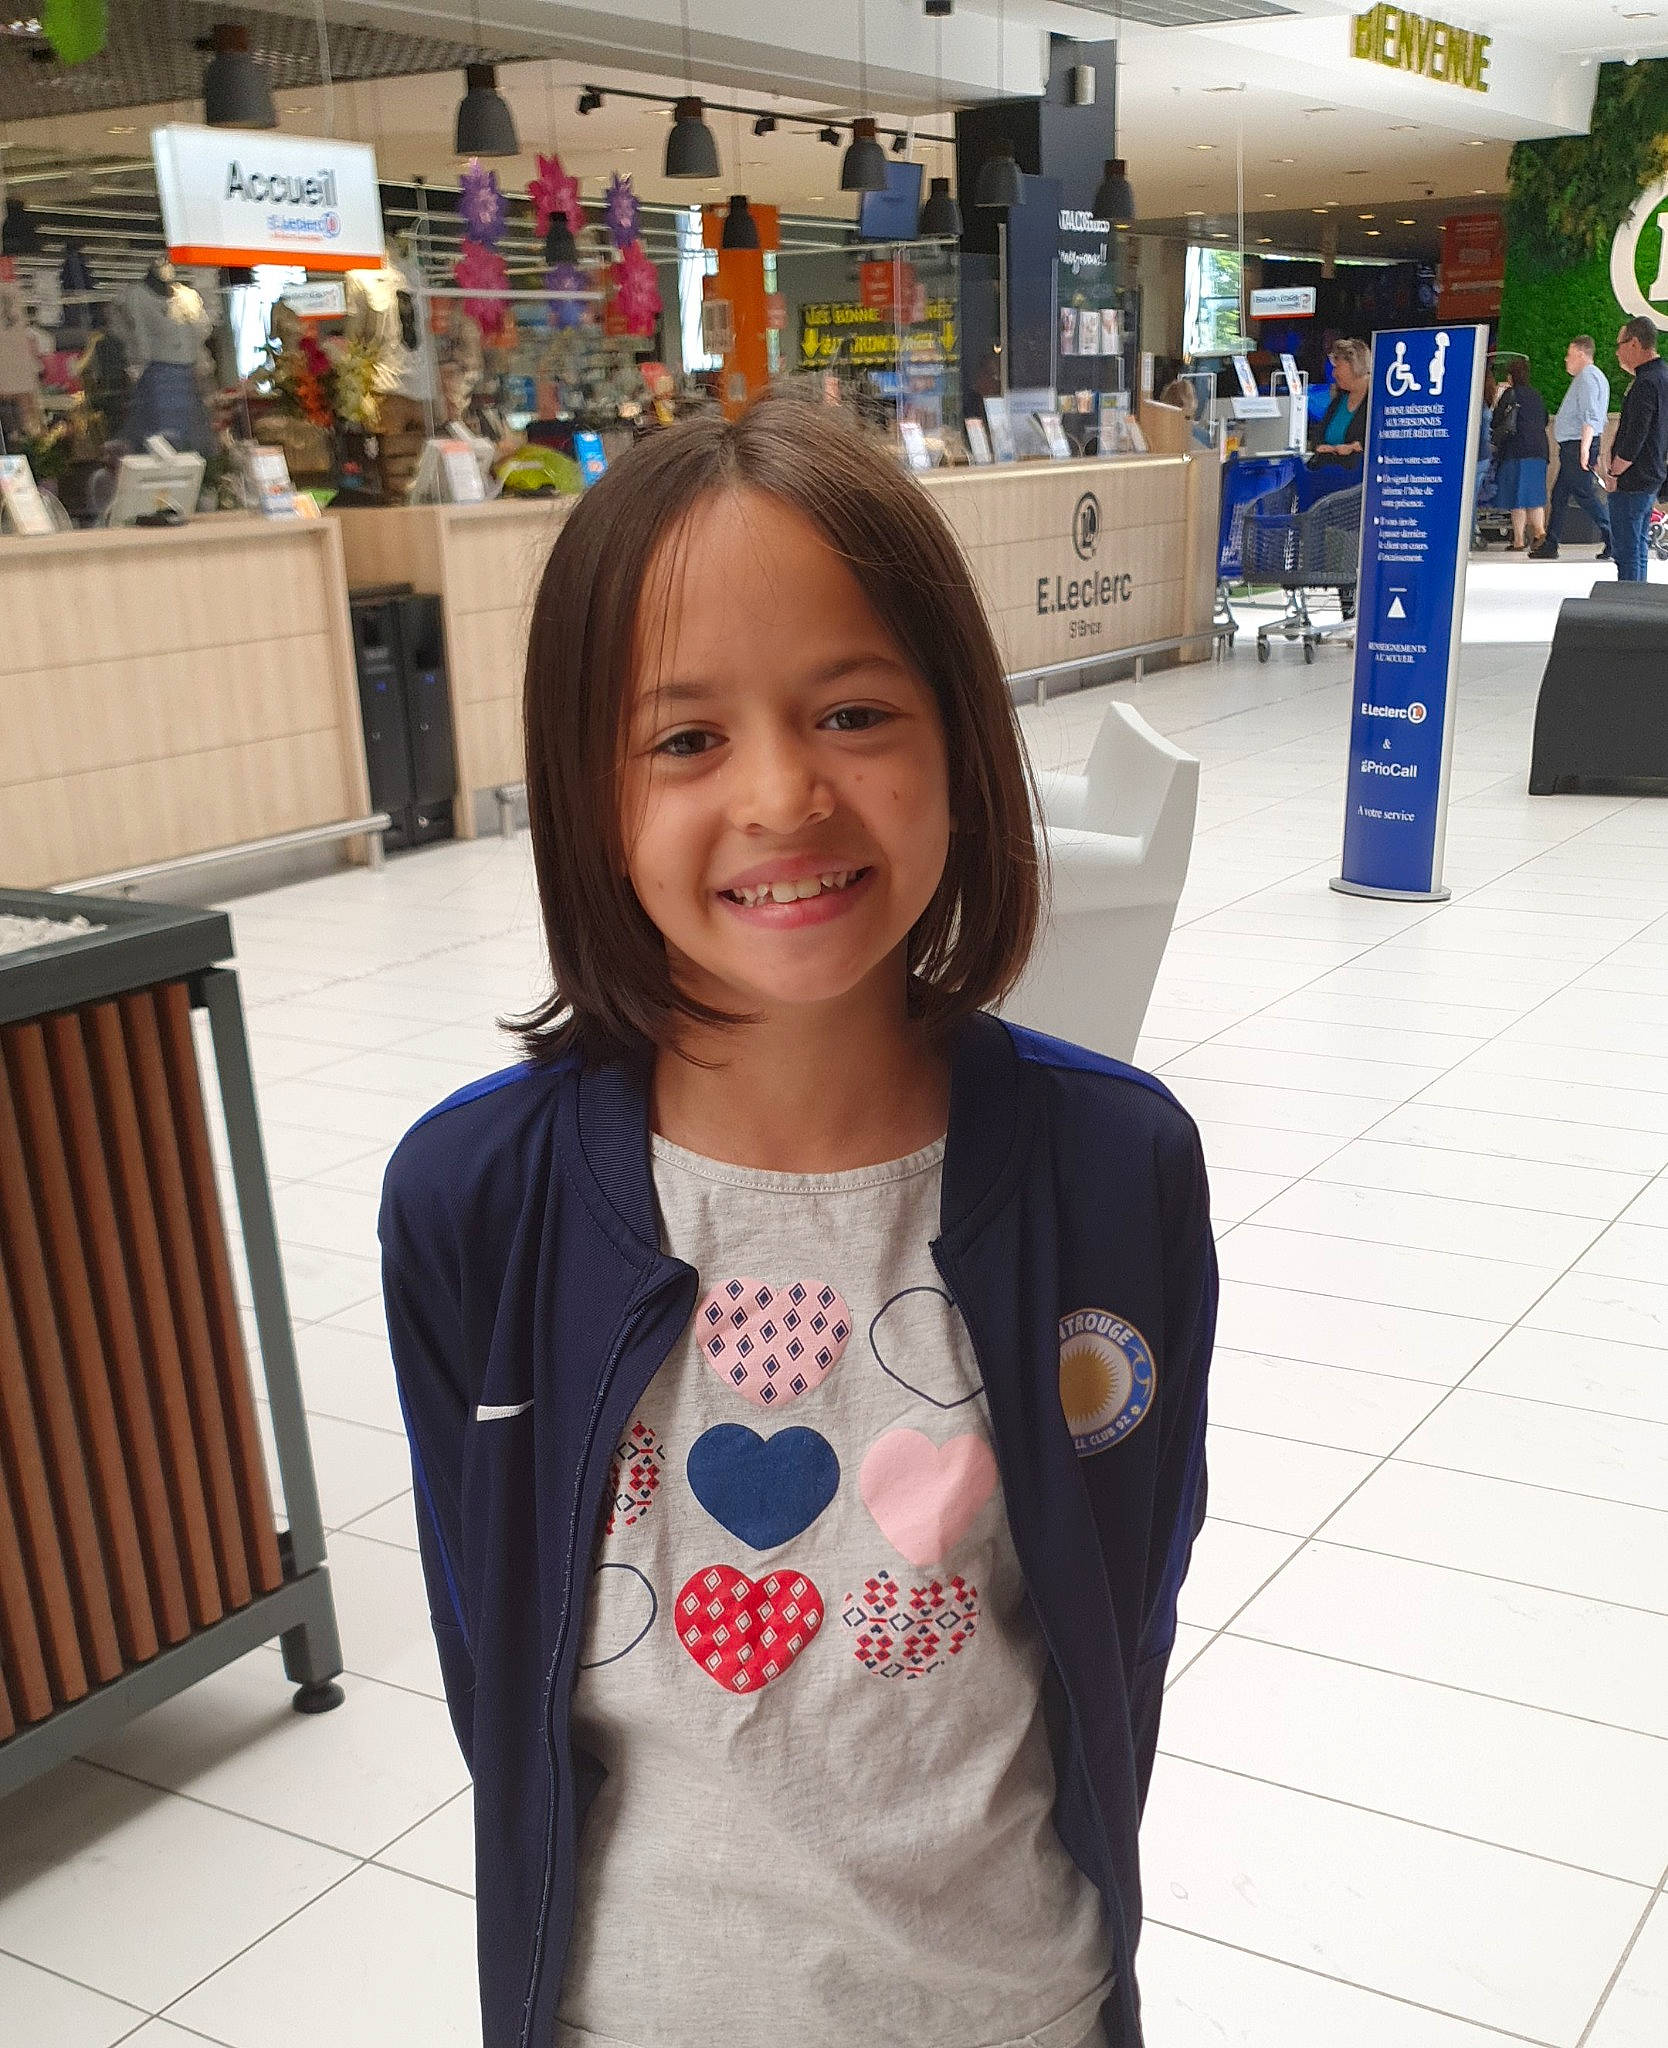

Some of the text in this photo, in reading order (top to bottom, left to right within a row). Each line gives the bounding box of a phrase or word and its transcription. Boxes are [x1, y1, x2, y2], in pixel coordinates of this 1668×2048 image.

[1350, 2, 1492, 93] BIENVENUE
[224, 159, 338, 208] Accueil
[1036, 569, 1133, 615] E.Leclerc
[1382, 738, 1392, 750] &
[1368, 760, 1418, 778] PrioCall
[1364, 807, 1383, 819] votre
[1384, 809, 1416, 821] service
[1090, 1427, 1116, 1445] CLUB
[1116, 1415, 1132, 1430] 92
